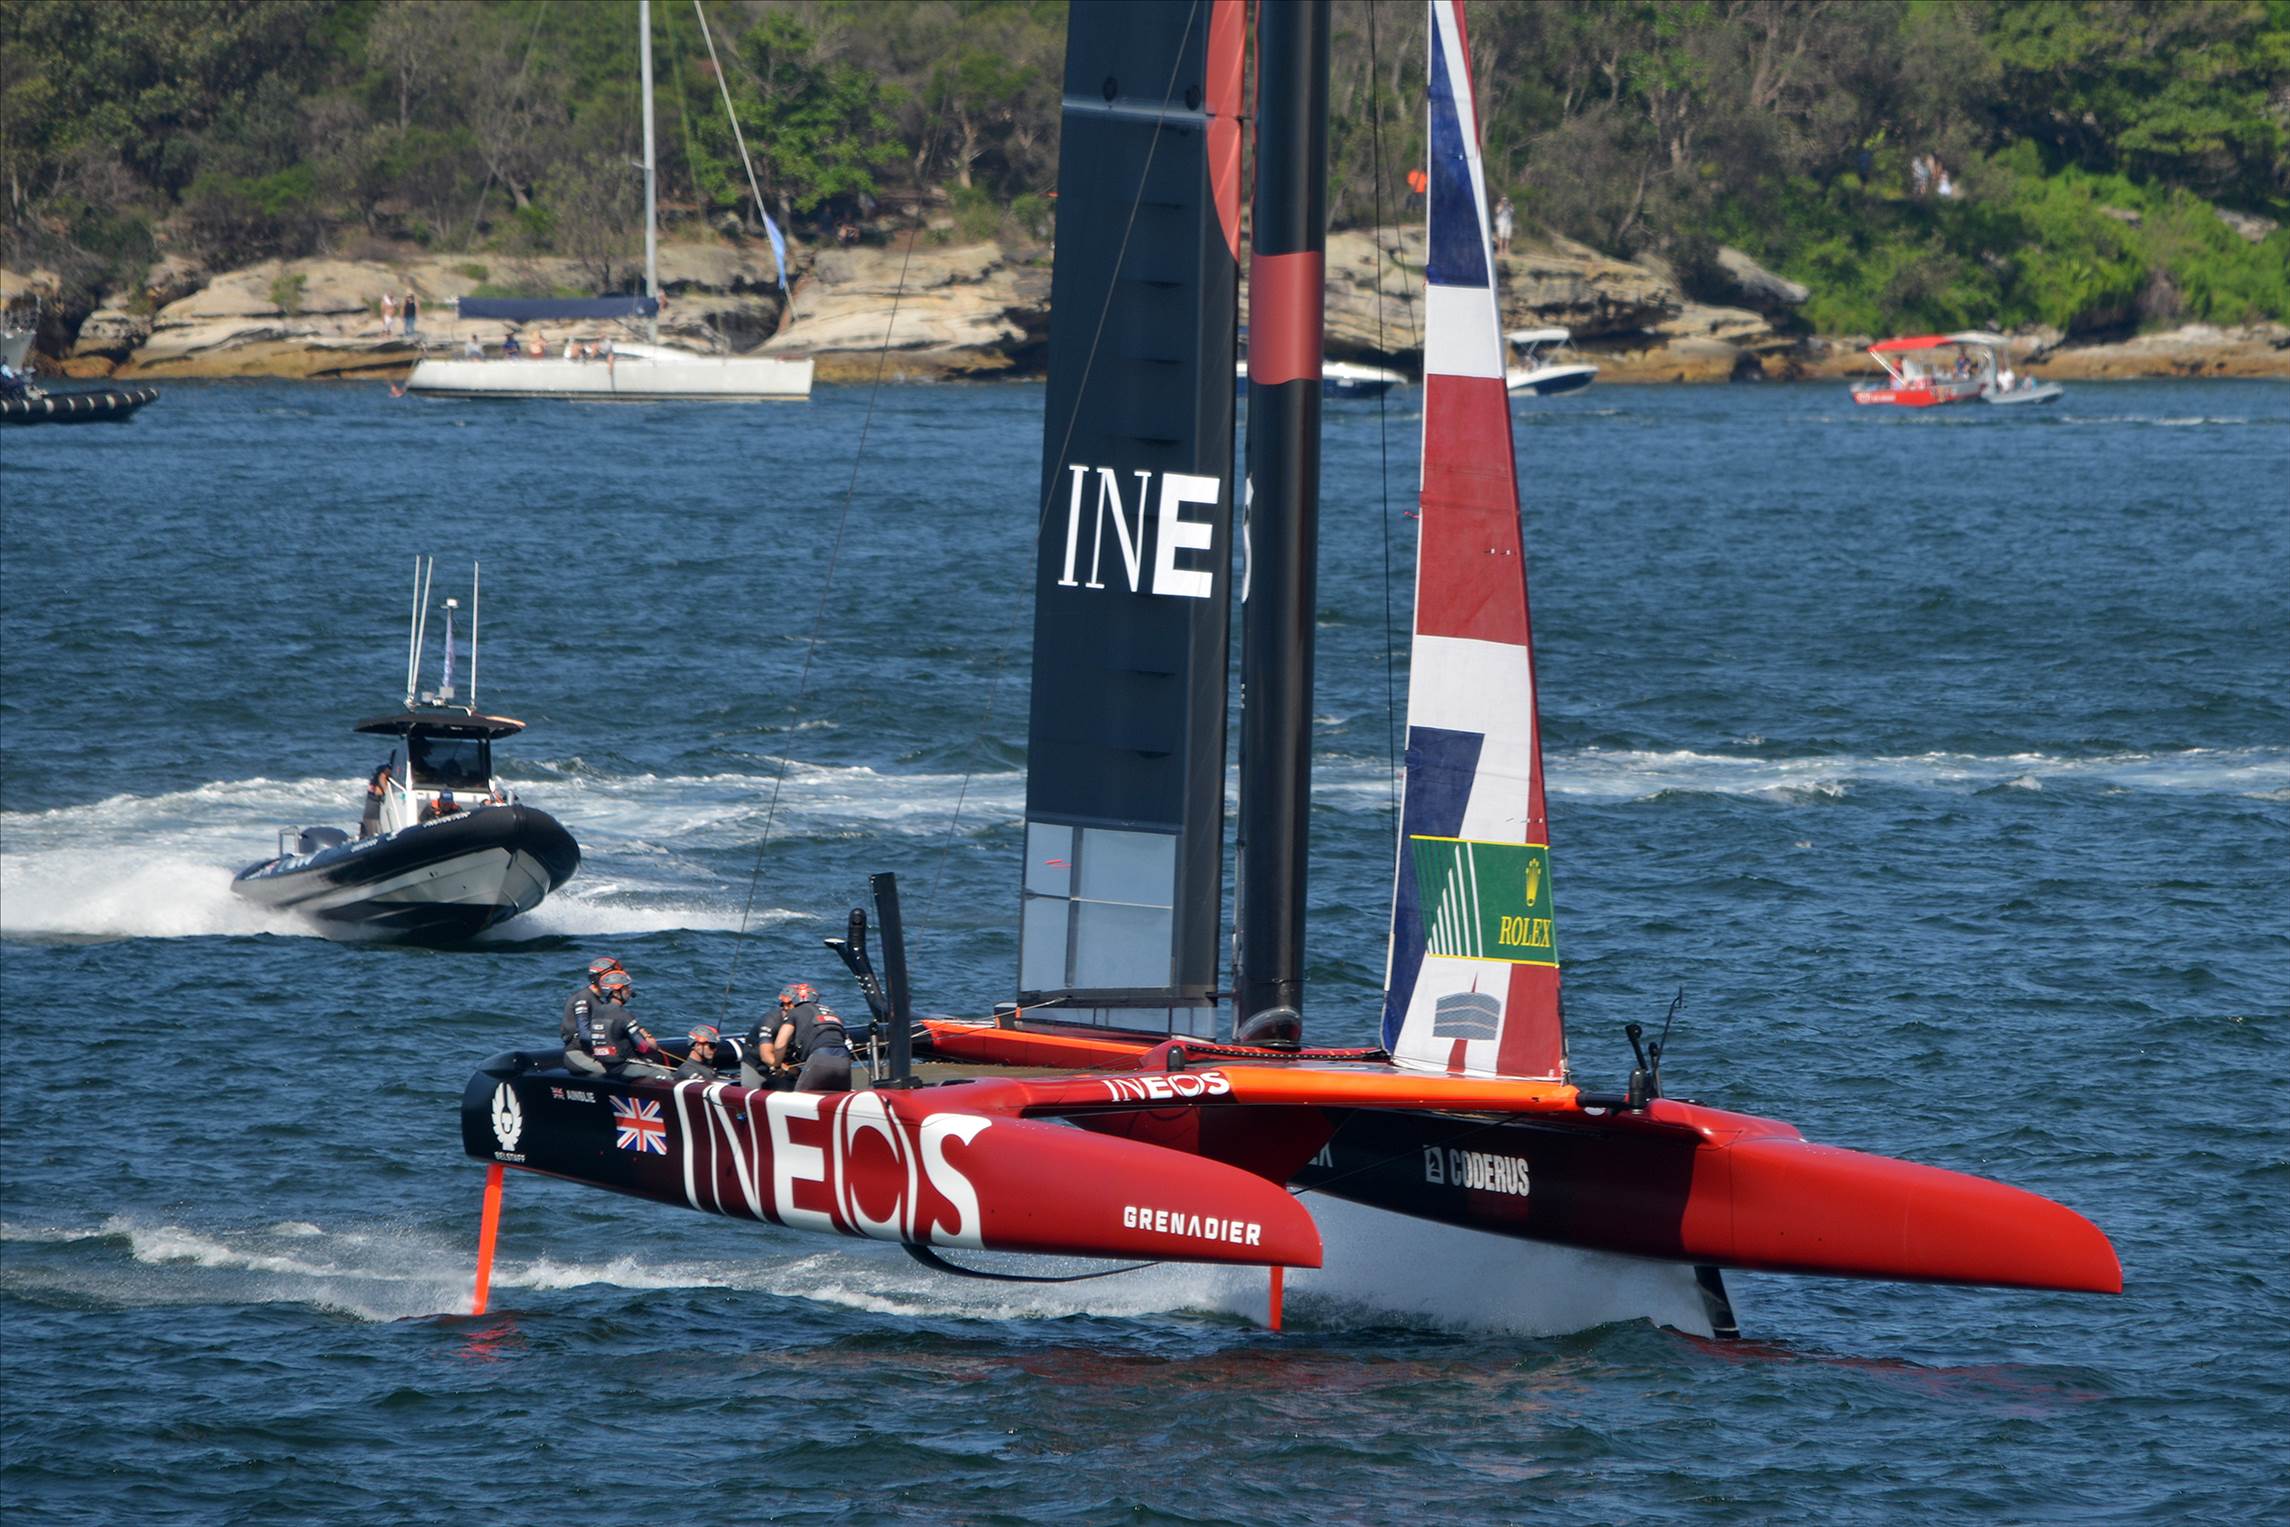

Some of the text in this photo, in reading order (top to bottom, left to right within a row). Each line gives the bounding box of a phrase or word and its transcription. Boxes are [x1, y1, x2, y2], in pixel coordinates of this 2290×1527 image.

[1498, 915, 1552, 948] ROLEX
[1101, 1071, 1231, 1102] INEOS
[494, 1151, 526, 1163] BELSTAFF
[673, 1079, 993, 1249] INEOS
[1449, 1148, 1531, 1197] CODERUS
[1123, 1205, 1262, 1246] GRENADIER
